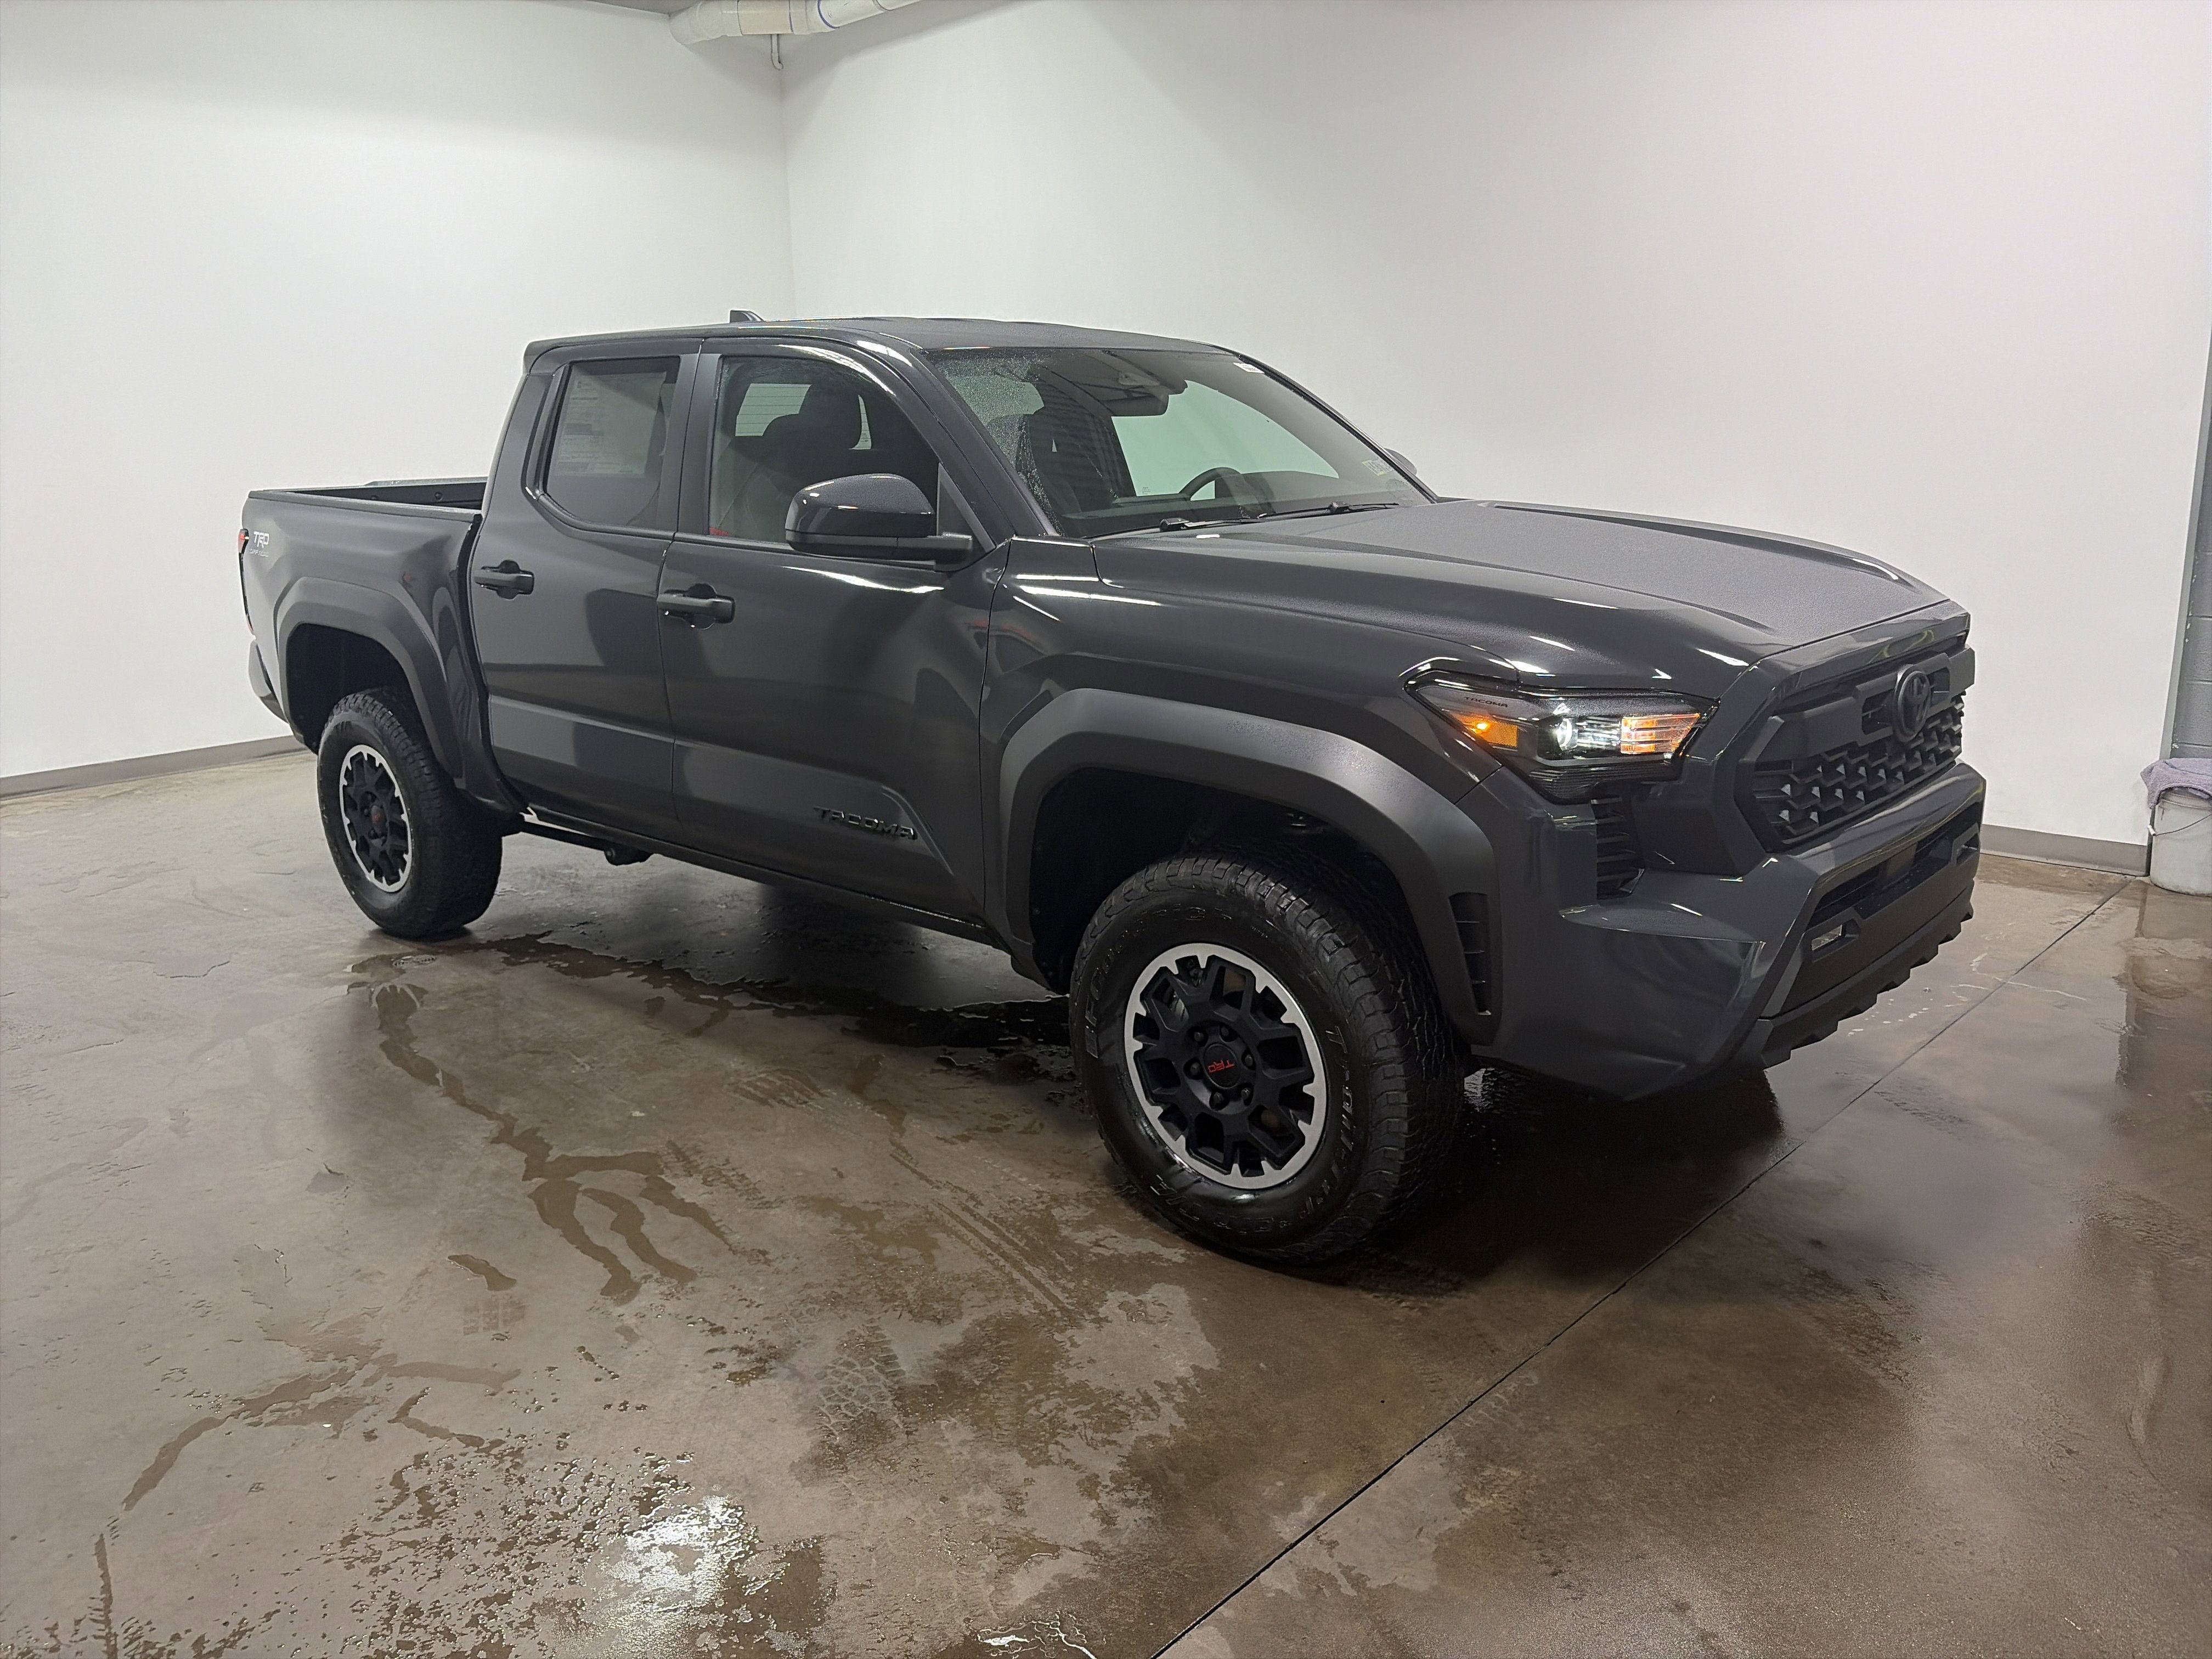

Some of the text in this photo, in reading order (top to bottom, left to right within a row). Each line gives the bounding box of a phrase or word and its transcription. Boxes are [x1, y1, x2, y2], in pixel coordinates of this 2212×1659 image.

[253, 531, 269, 548] TRD
[1464, 696, 1508, 708] TACOMA
[814, 805, 918, 840] TACOMA
[1208, 1059, 1235, 1073] TRD
